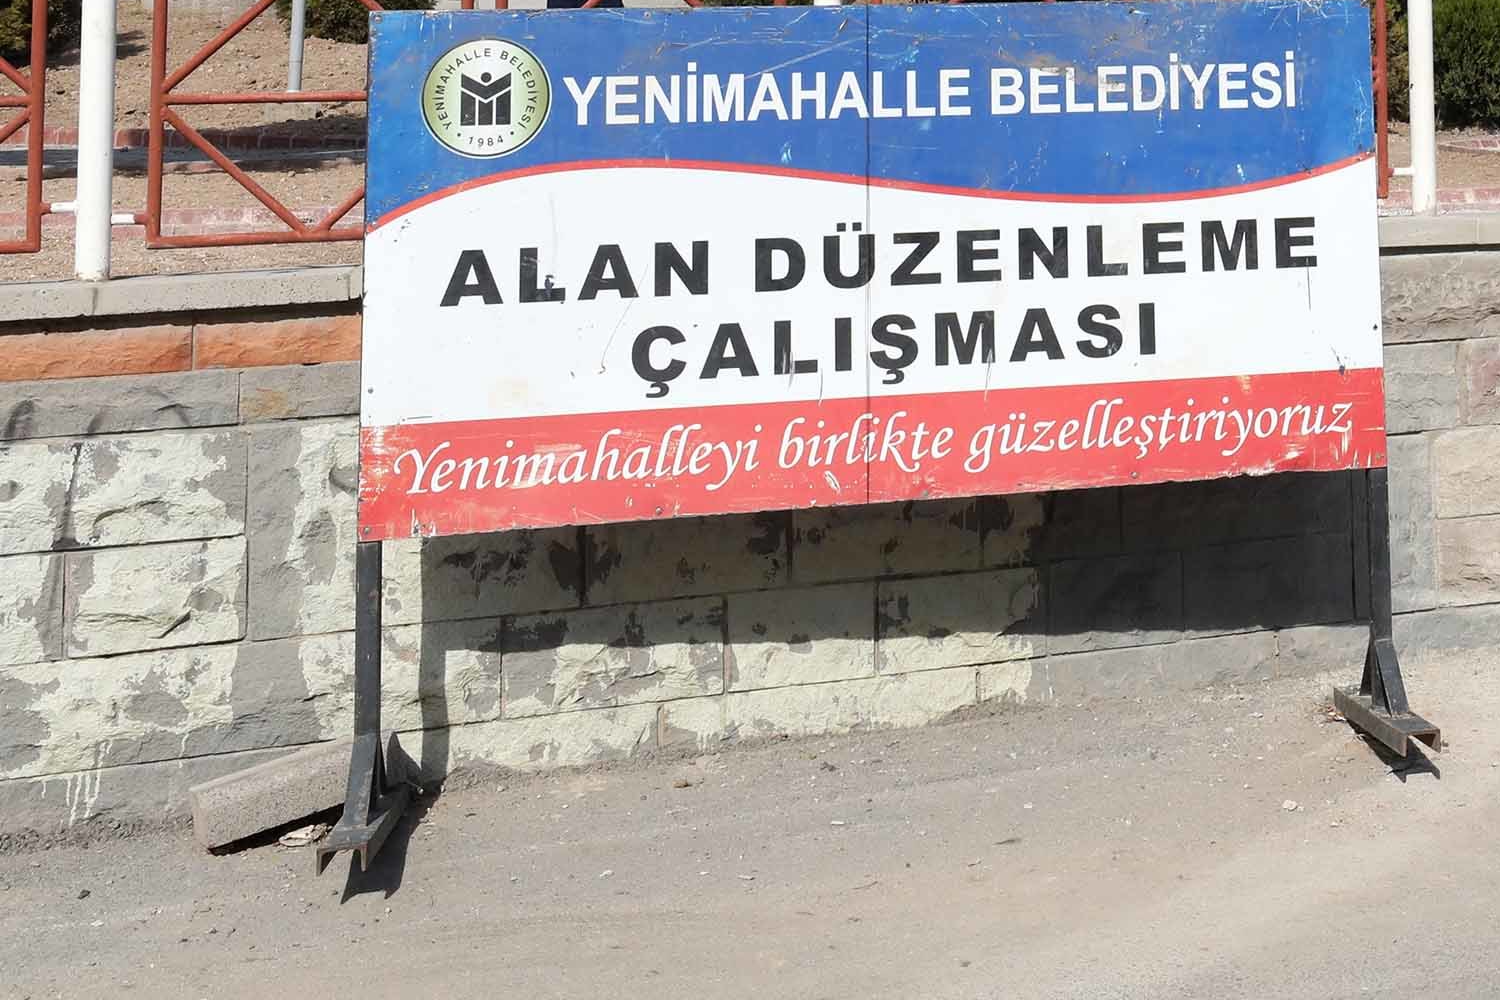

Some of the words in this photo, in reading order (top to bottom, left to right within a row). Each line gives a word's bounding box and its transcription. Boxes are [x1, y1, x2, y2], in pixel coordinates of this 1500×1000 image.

[562, 60, 972, 127] YENİMAHALLE
[989, 50, 1297, 116] BELEDİYESİ
[468, 135, 504, 148] 1984
[438, 239, 710, 308] ALAN
[754, 216, 1319, 293] DÜZENLEME
[630, 302, 1157, 399] ÇALIŞMASI
[393, 422, 760, 495] Yenimahalleyi
[777, 410, 955, 474] birlikte
[963, 396, 1354, 473] güzelleştiriyoruz
